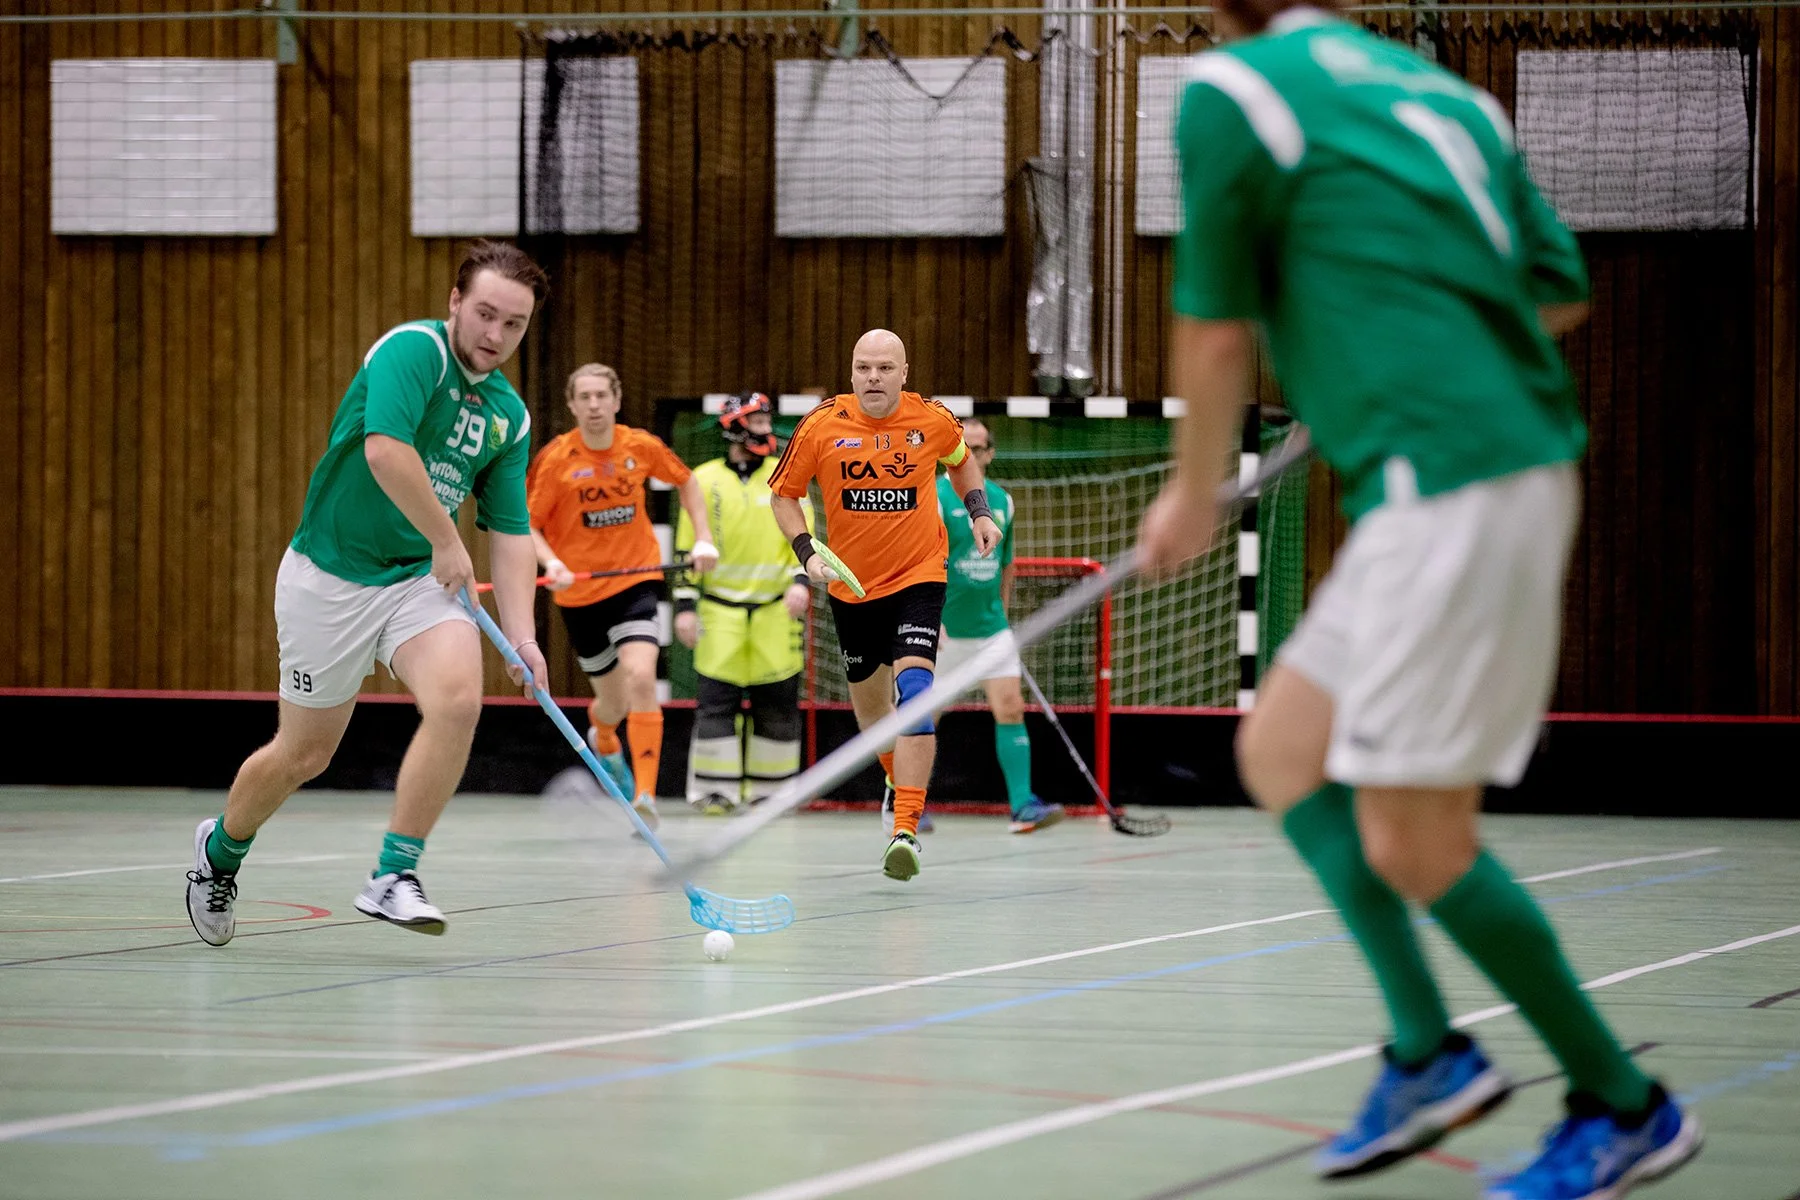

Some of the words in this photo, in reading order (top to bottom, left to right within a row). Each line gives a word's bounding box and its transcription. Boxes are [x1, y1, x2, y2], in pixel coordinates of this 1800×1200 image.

[875, 434, 890, 450] 13
[894, 452, 907, 465] SJ
[840, 460, 879, 480] ICA
[579, 486, 609, 504] ICA
[850, 490, 909, 503] VISION
[851, 503, 909, 511] HAIRCARE
[293, 670, 312, 693] 99
